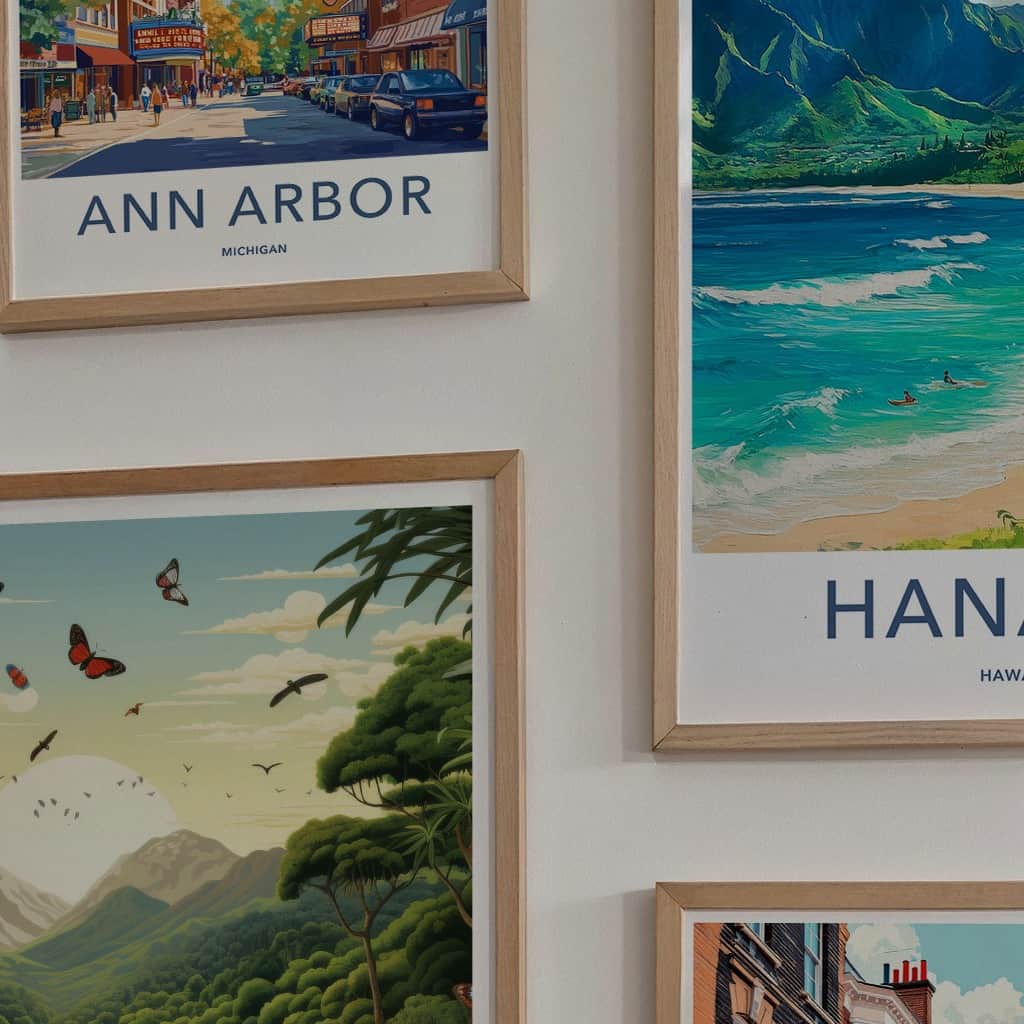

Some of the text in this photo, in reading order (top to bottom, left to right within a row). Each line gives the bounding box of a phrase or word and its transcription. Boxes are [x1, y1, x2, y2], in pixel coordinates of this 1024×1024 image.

[76, 175, 432, 236] ANN ARBOR
[221, 243, 288, 257] MICHIGAN
[826, 577, 1024, 639] HAN
[980, 669, 1024, 682] HAW
